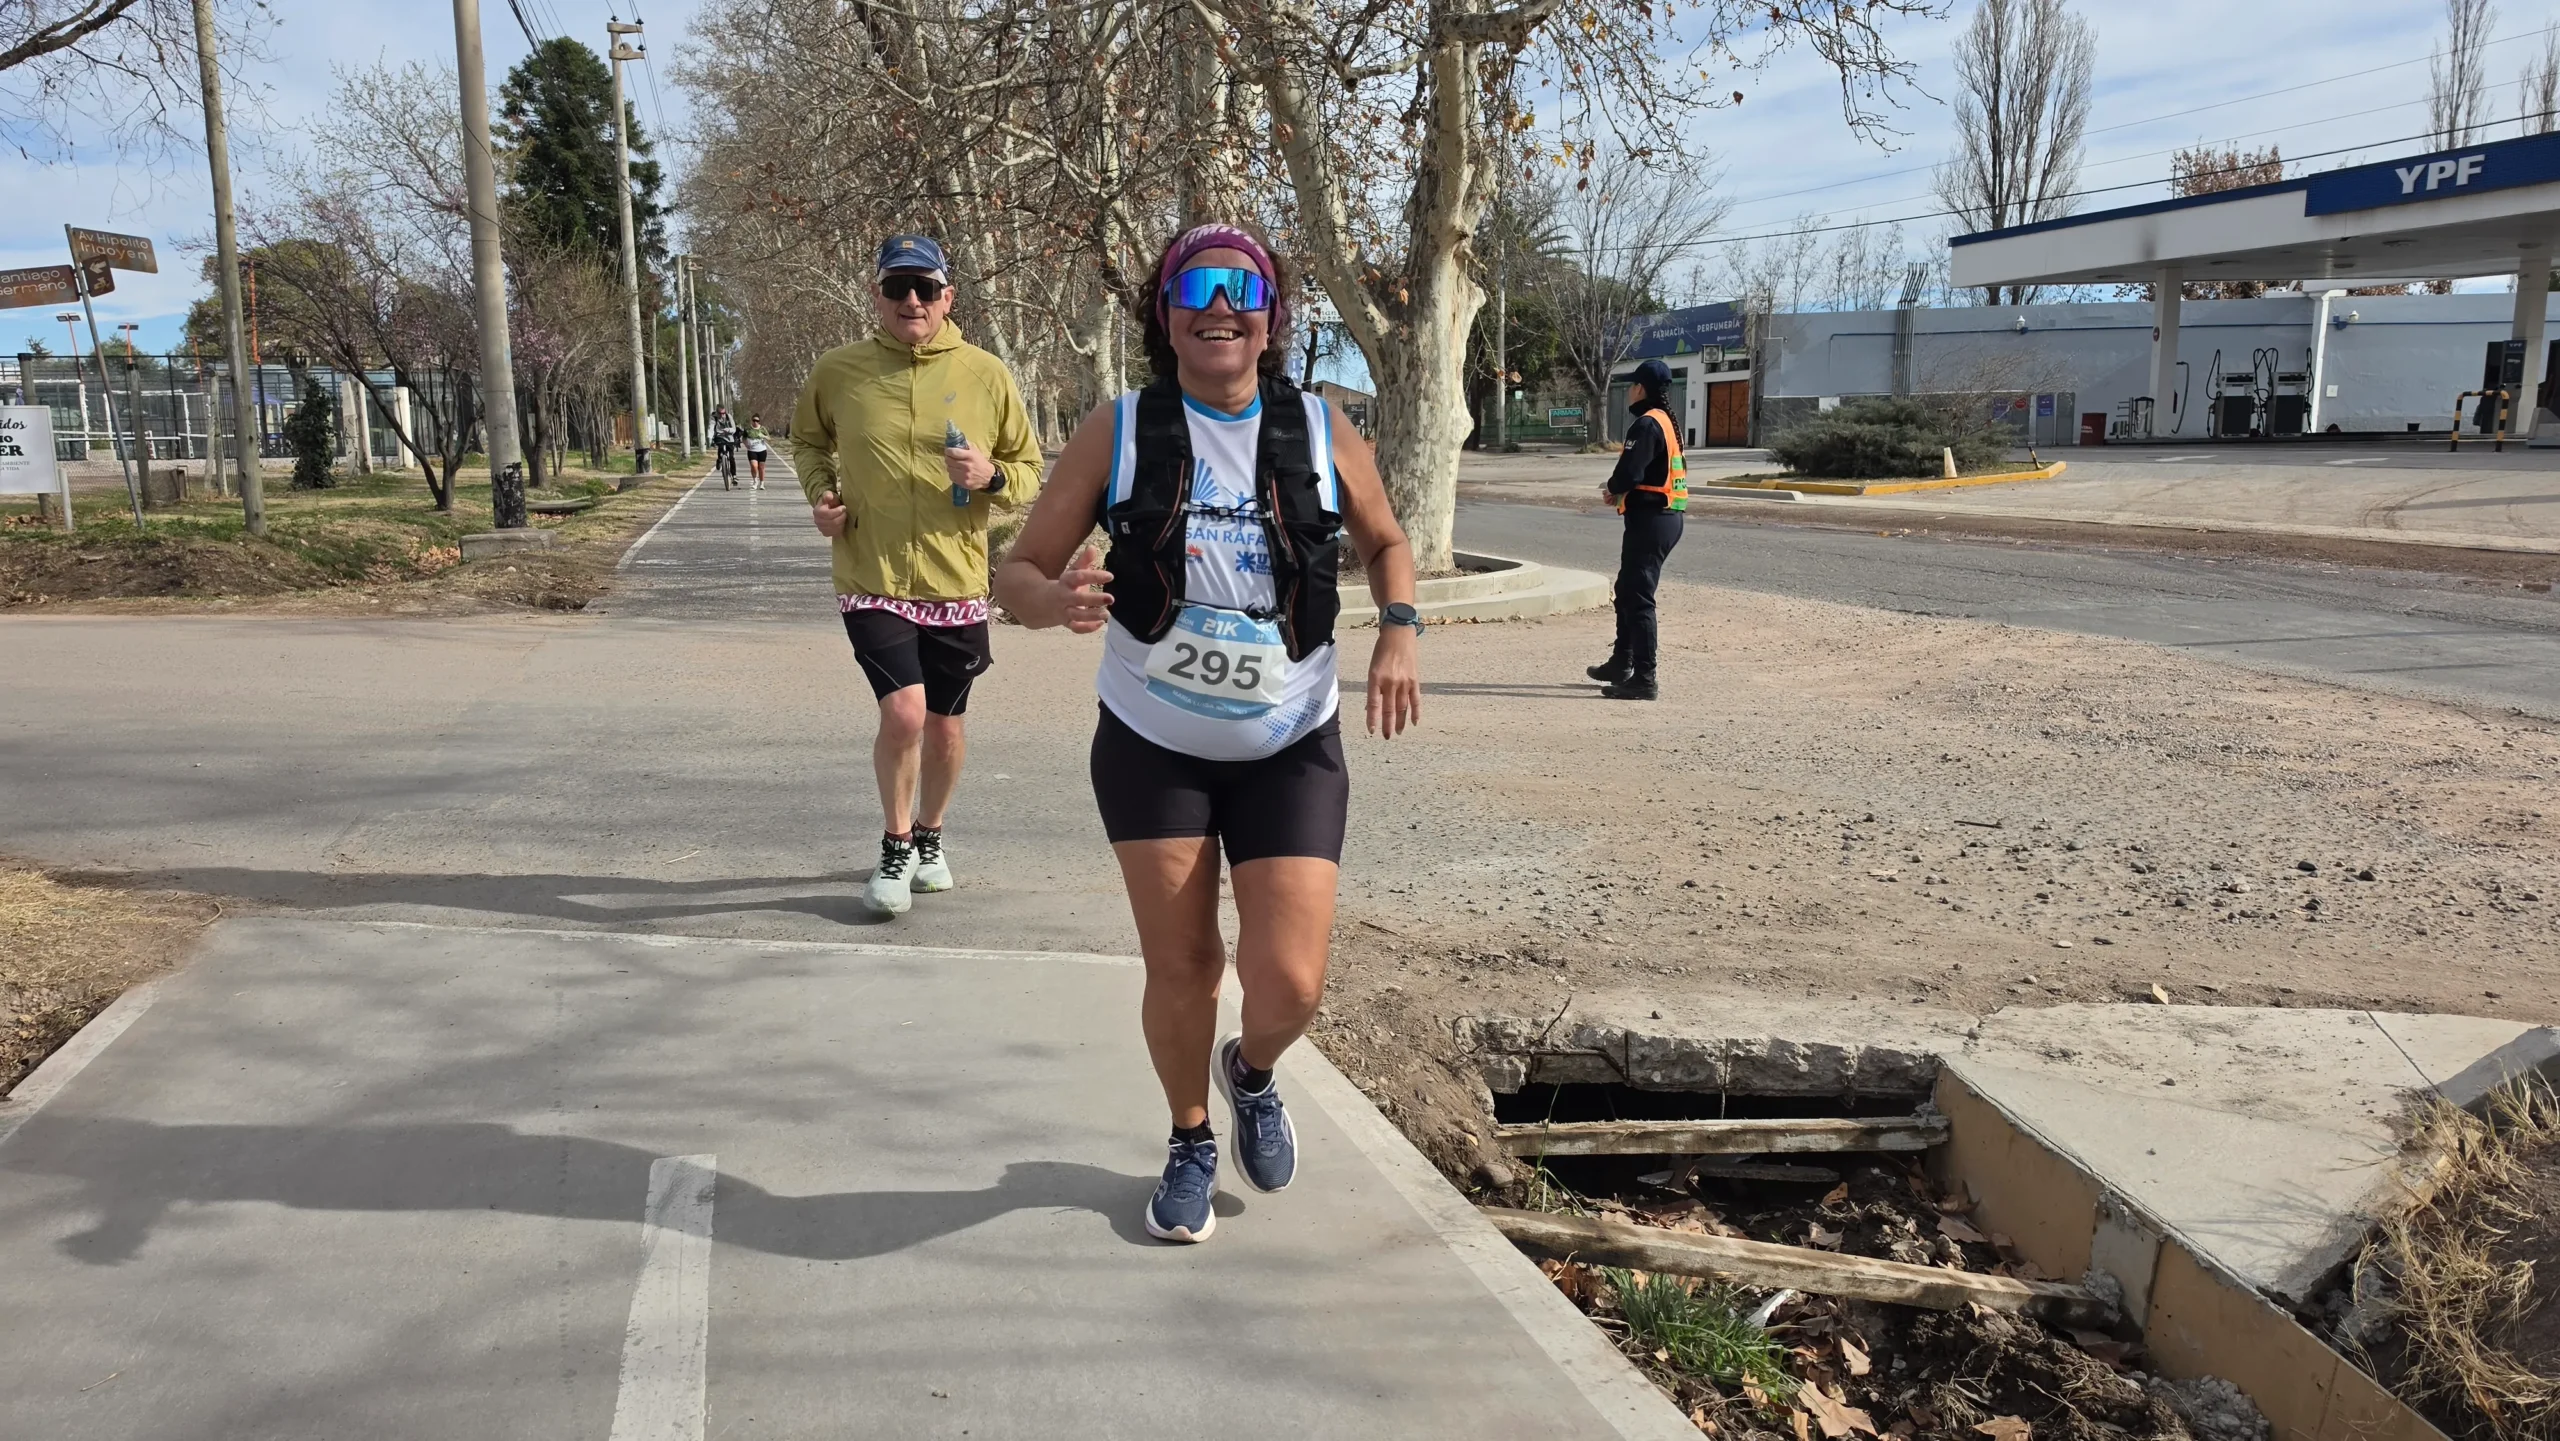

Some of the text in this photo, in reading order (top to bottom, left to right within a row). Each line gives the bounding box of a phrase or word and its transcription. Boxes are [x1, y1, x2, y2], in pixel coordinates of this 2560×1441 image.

[2395, 154, 2485, 194] YPF
[1652, 327, 1685, 340] FARMACIA
[1185, 527, 1218, 542] SAN
[1202, 617, 1241, 637] 21K
[1167, 642, 1262, 690] 295
